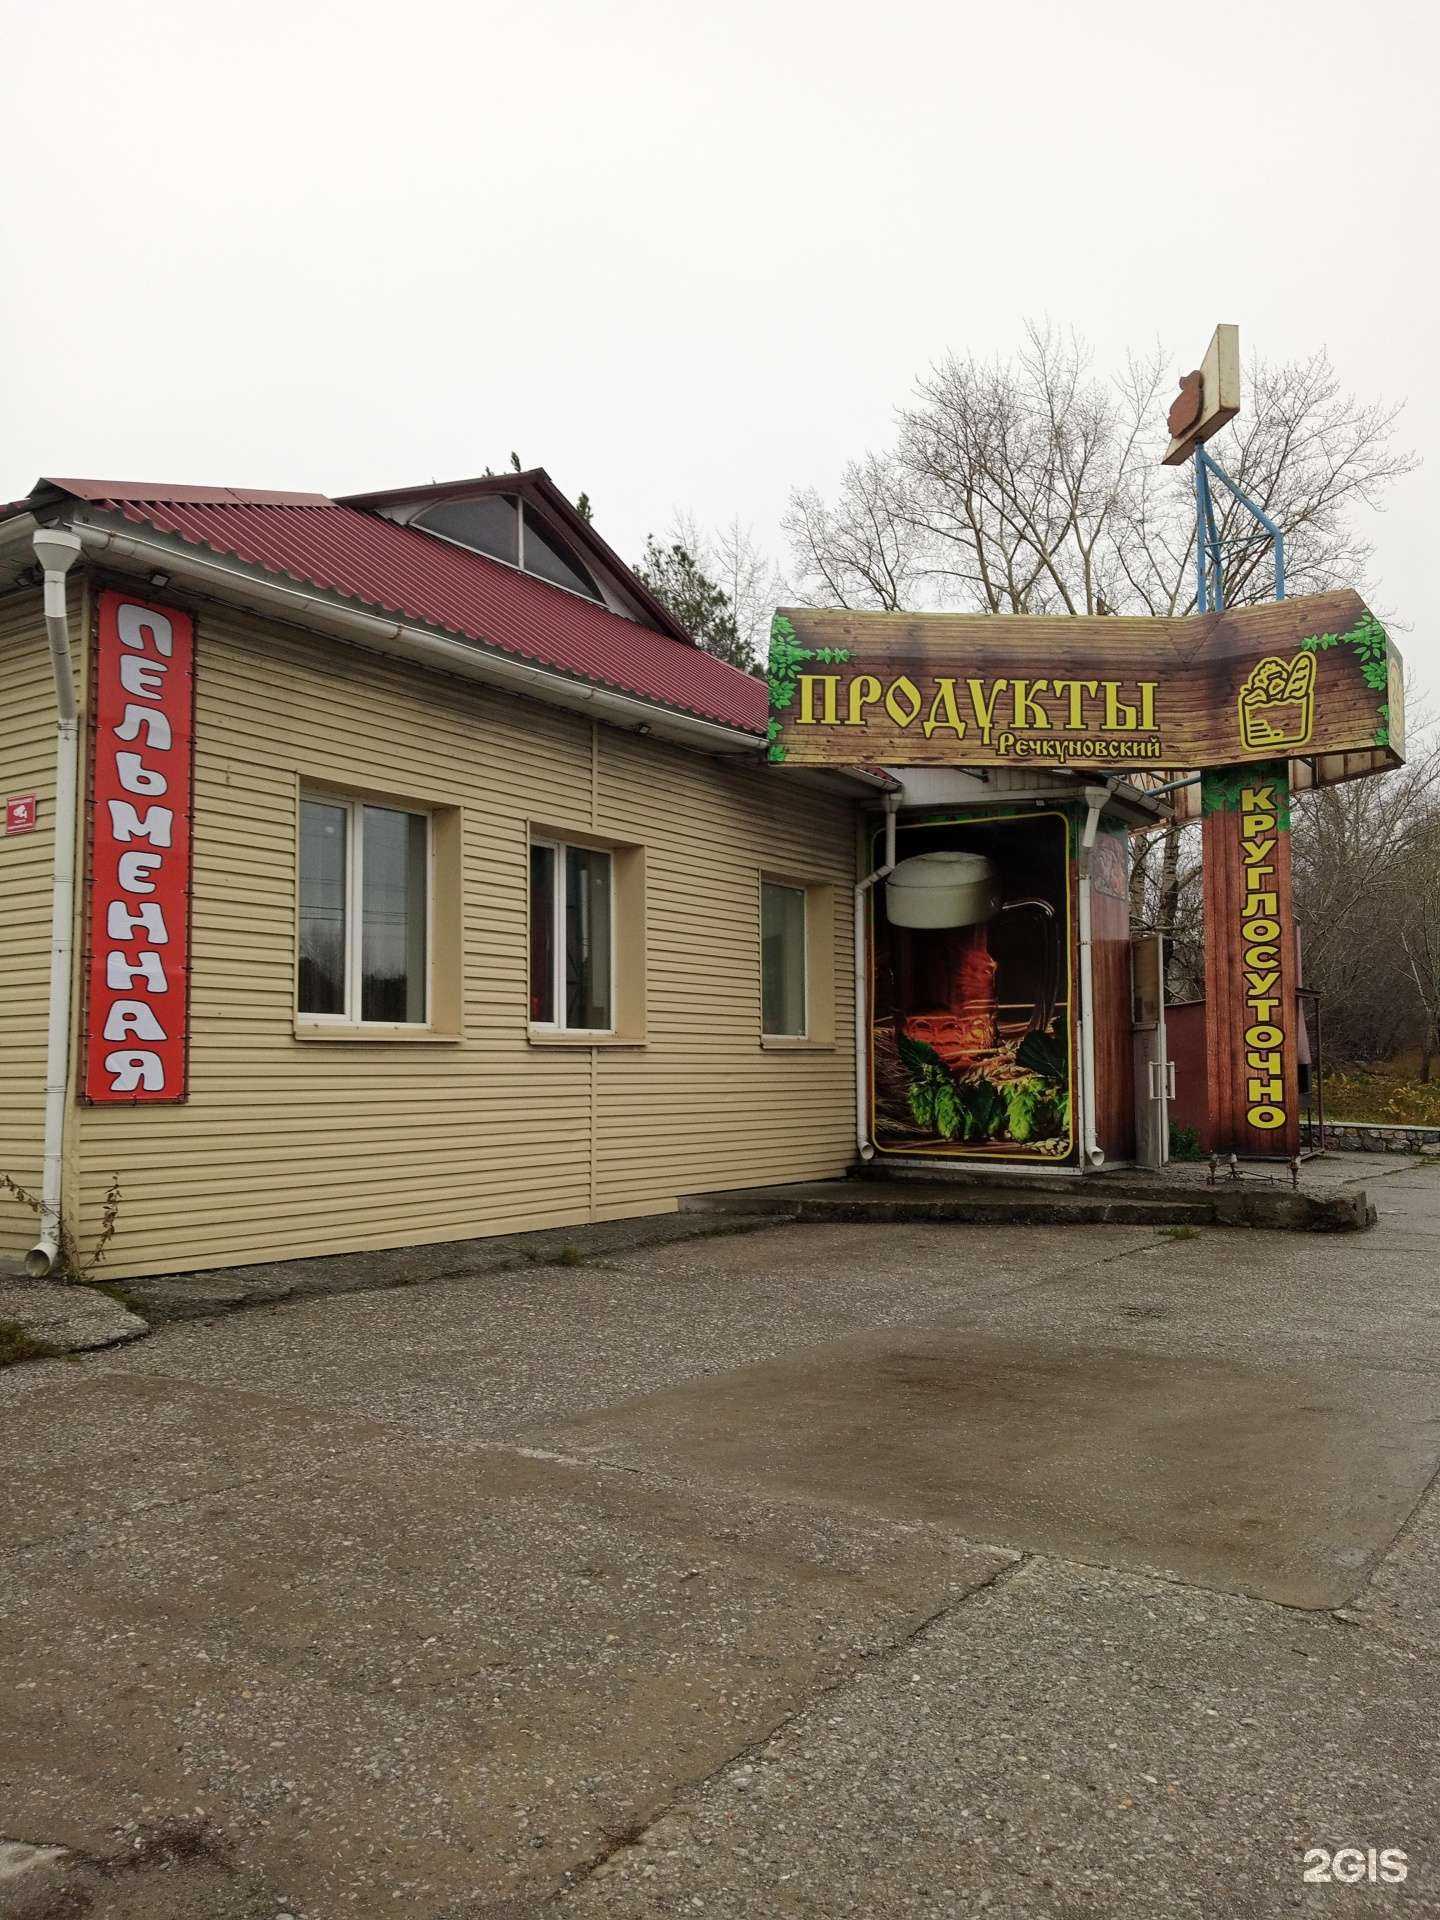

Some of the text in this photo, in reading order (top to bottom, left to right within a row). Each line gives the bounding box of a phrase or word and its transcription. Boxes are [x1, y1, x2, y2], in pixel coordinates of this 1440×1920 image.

[796, 674, 1160, 745] ПРОДУКТЫ
[997, 732, 1161, 764] Речкуновский
[103, 603, 173, 1092] ПЕЛЬМЕННАЯ
[1241, 786, 1287, 1130] КРУГЛОСУТОЧНО
